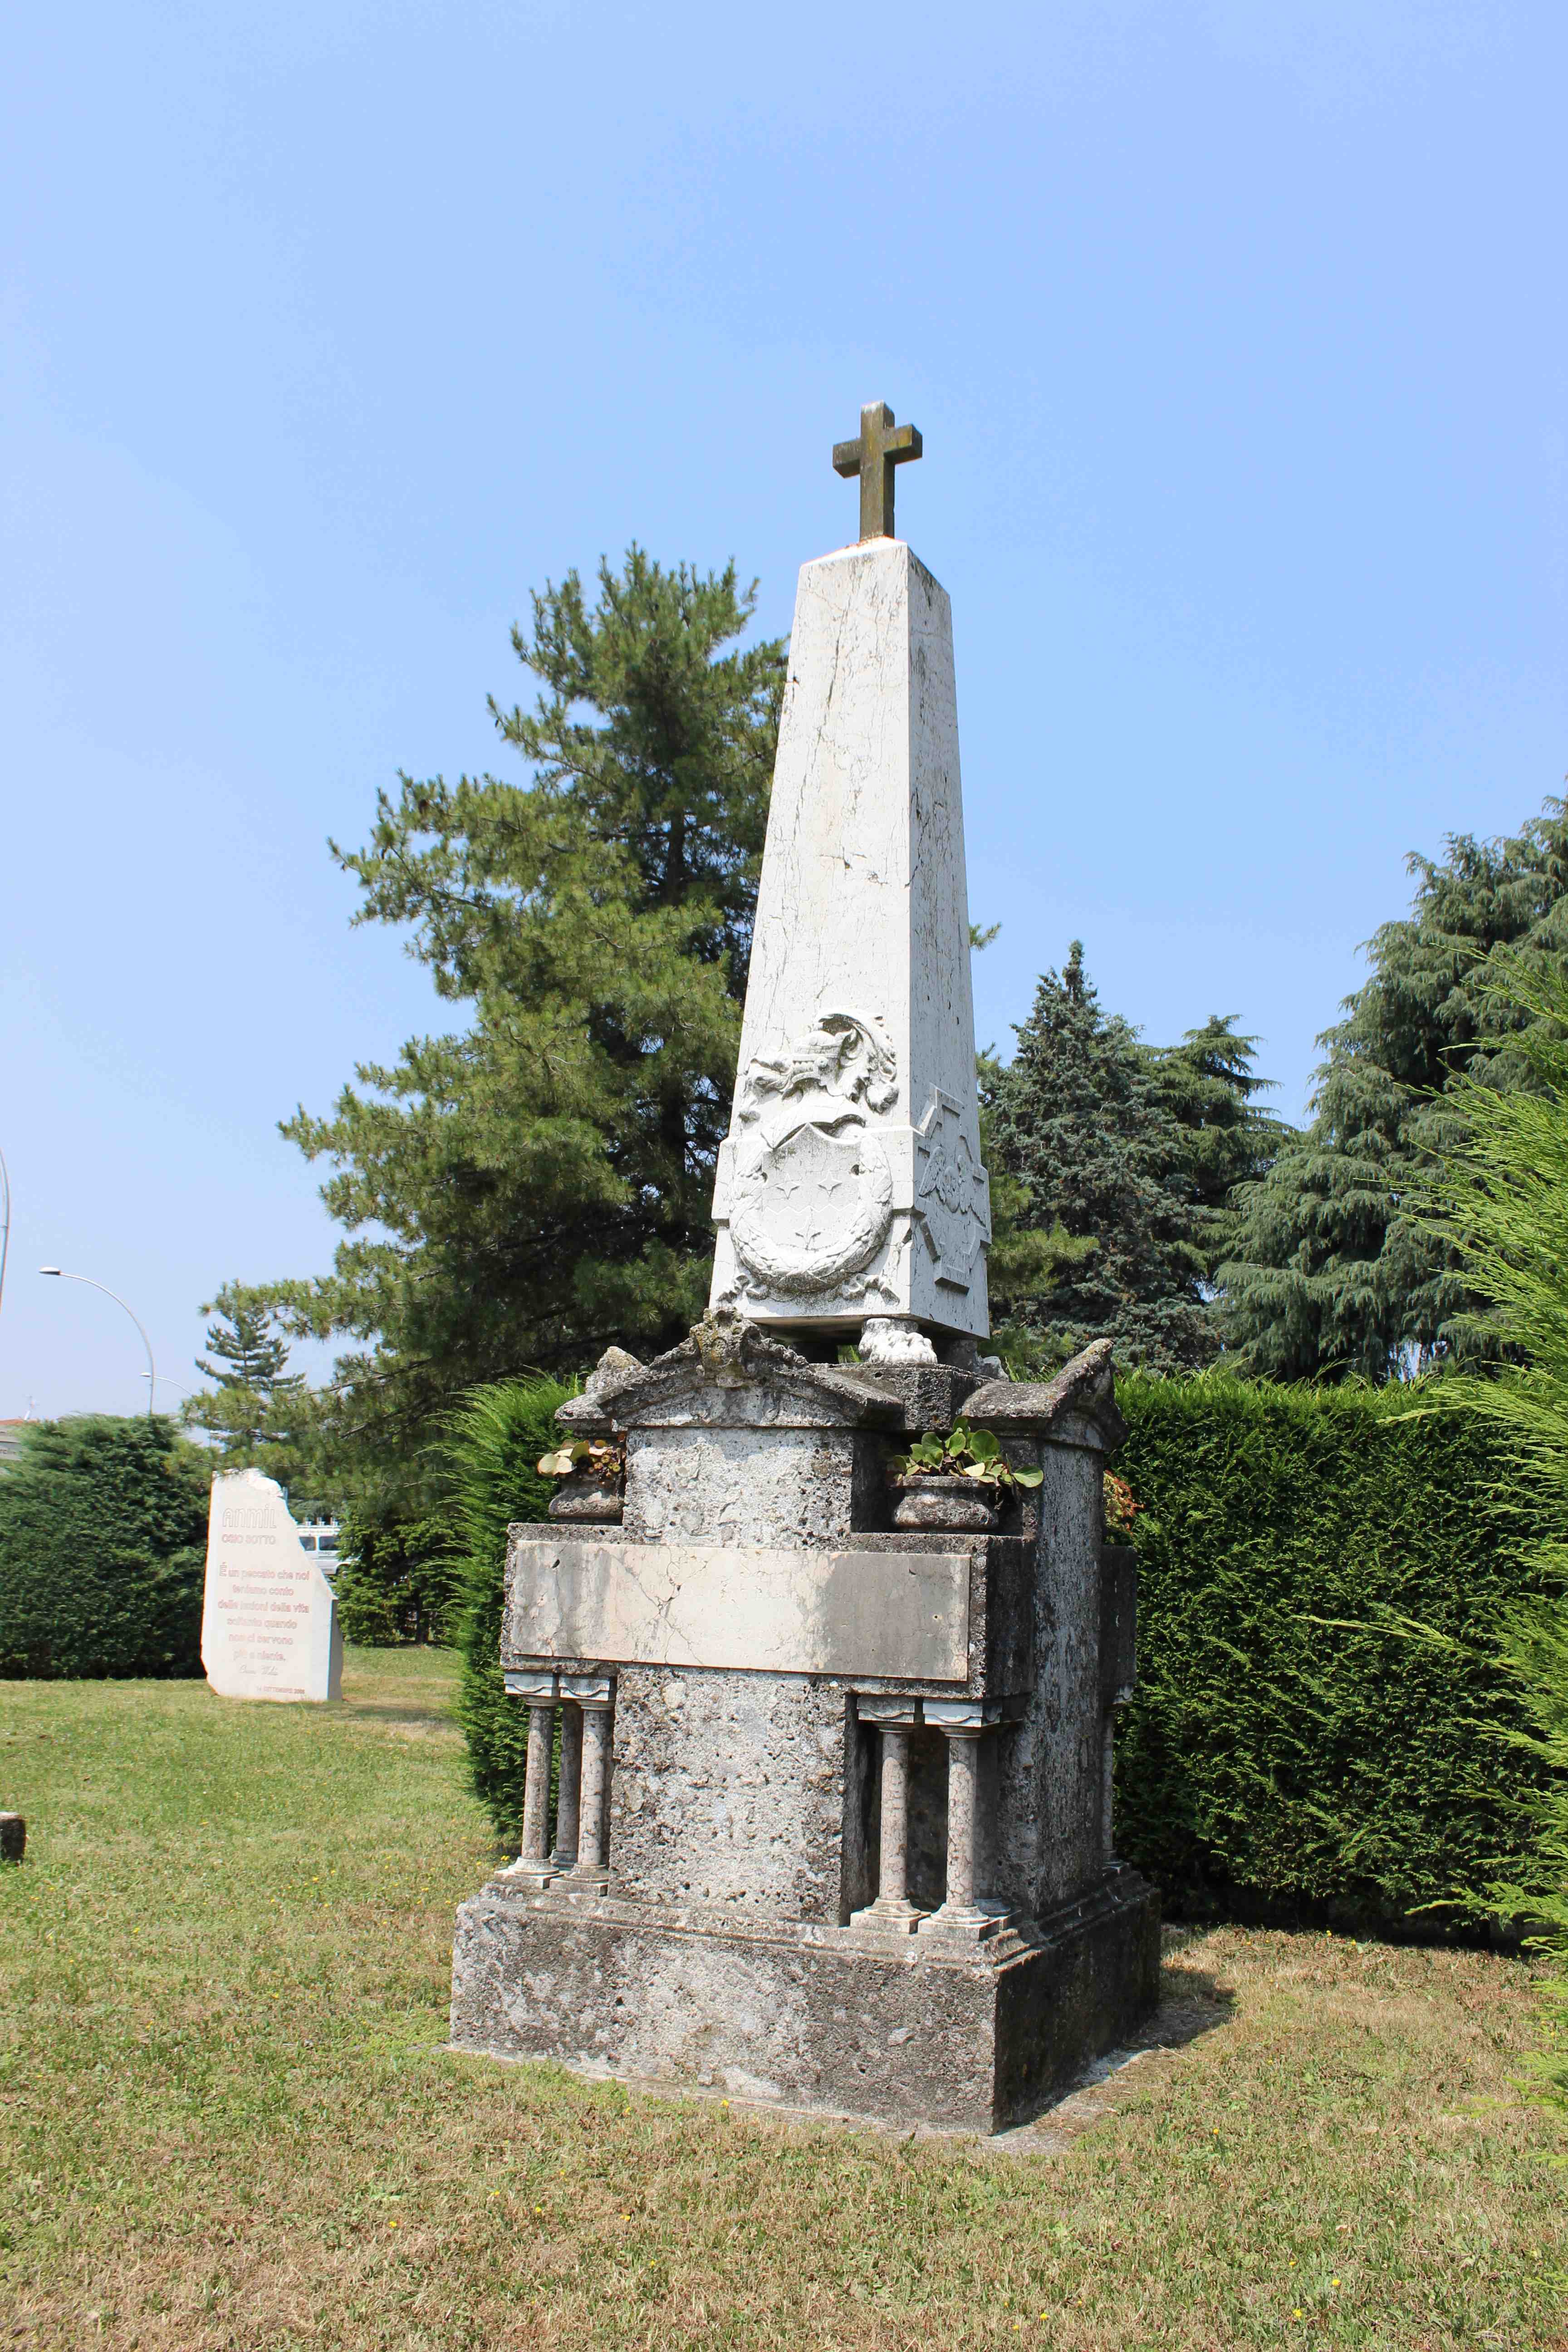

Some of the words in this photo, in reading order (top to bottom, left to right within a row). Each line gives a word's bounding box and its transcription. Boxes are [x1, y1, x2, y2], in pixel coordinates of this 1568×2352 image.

[245, 1534, 276, 1545] SOTTO
[228, 1569, 240, 1577] un
[241, 1568, 275, 1580] peccato
[277, 1569, 293, 1580] che
[295, 1570, 309, 1580] noi
[232, 1584, 266, 1594] teniamo
[269, 1585, 294, 1596] conto
[218, 1599, 238, 1609] delle
[270, 1602, 291, 1612] della
[293, 1603, 309, 1613] vita
[264, 1618, 298, 1629] quando
[257, 1635, 294, 1645] servono
